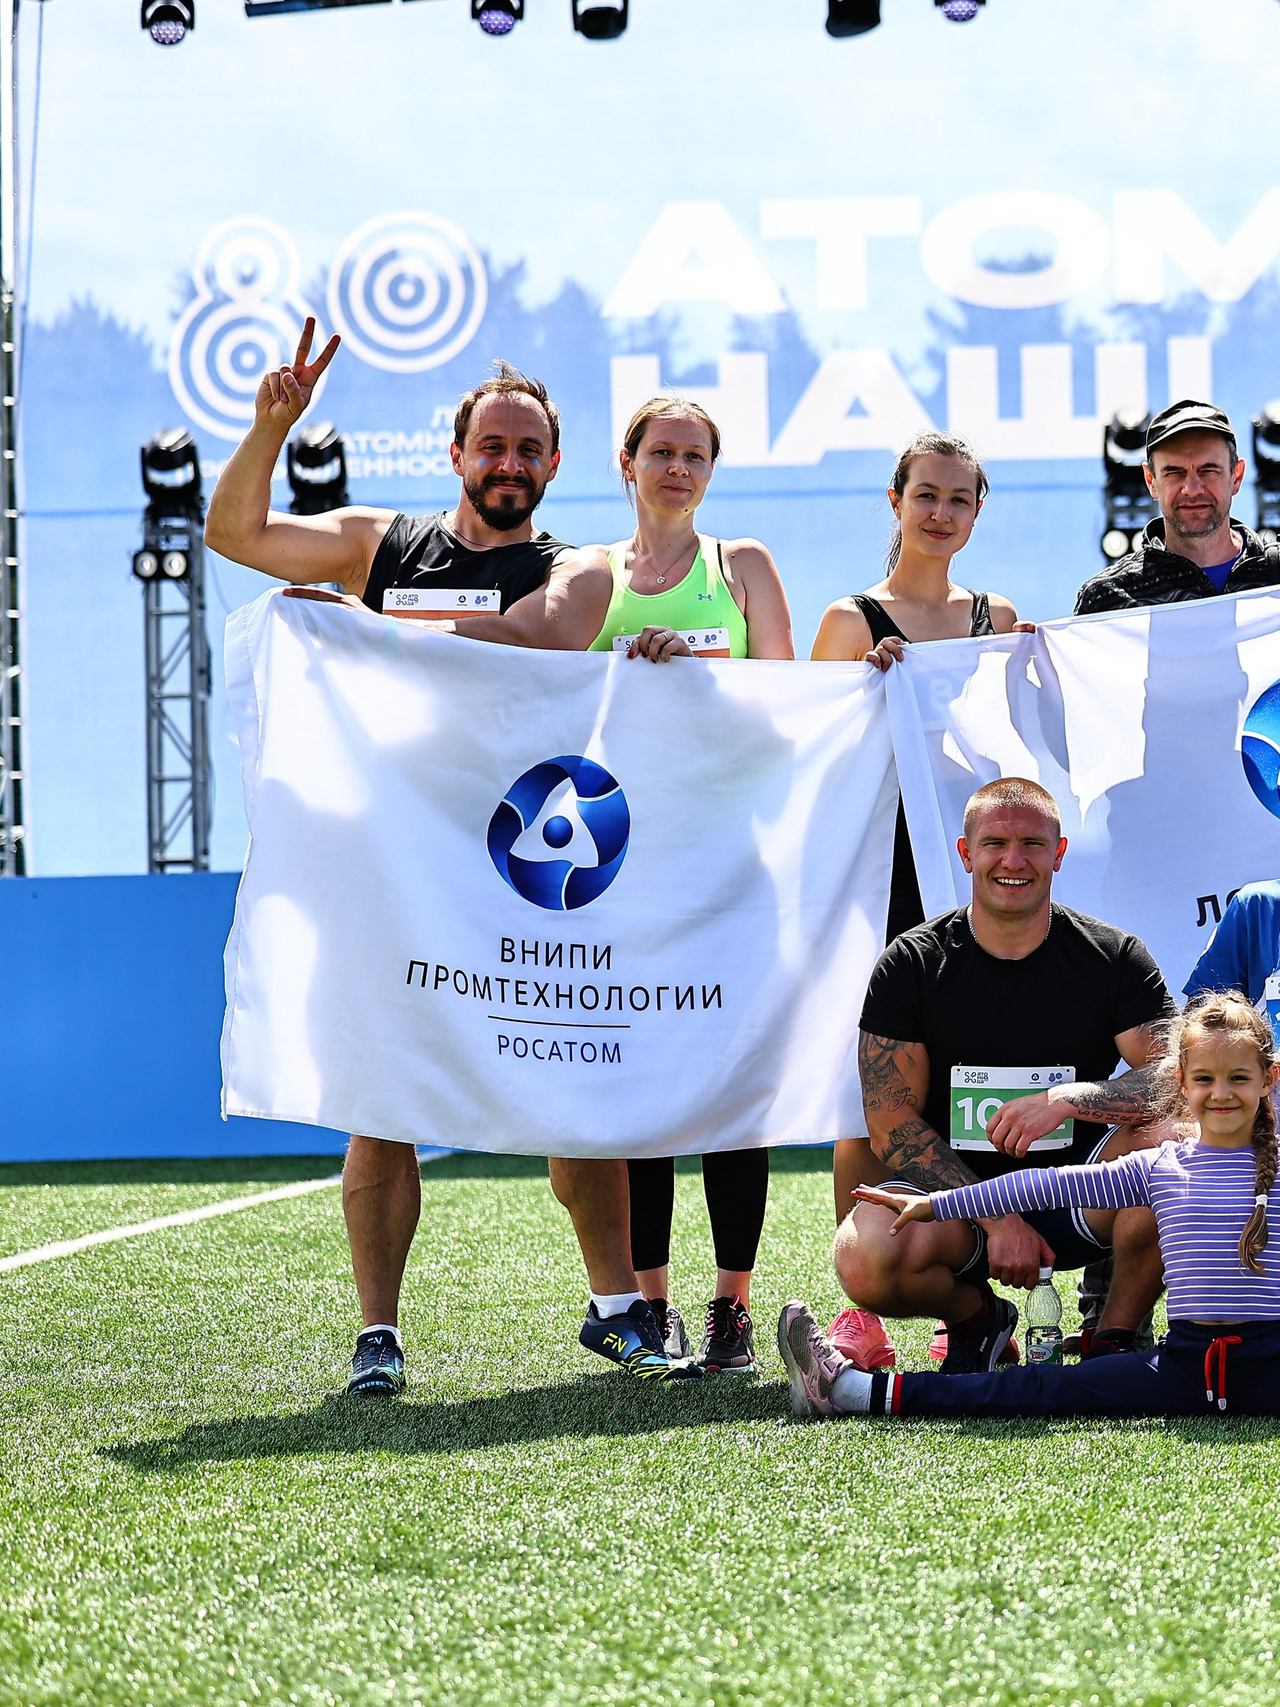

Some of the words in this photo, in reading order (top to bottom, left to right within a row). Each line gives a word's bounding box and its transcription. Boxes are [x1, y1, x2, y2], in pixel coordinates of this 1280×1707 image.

[500, 937, 612, 971] ВНИПИ
[405, 959, 724, 1011] ПРОМТЕХНОЛОГИИ
[497, 1034, 622, 1064] РОСАТОМ
